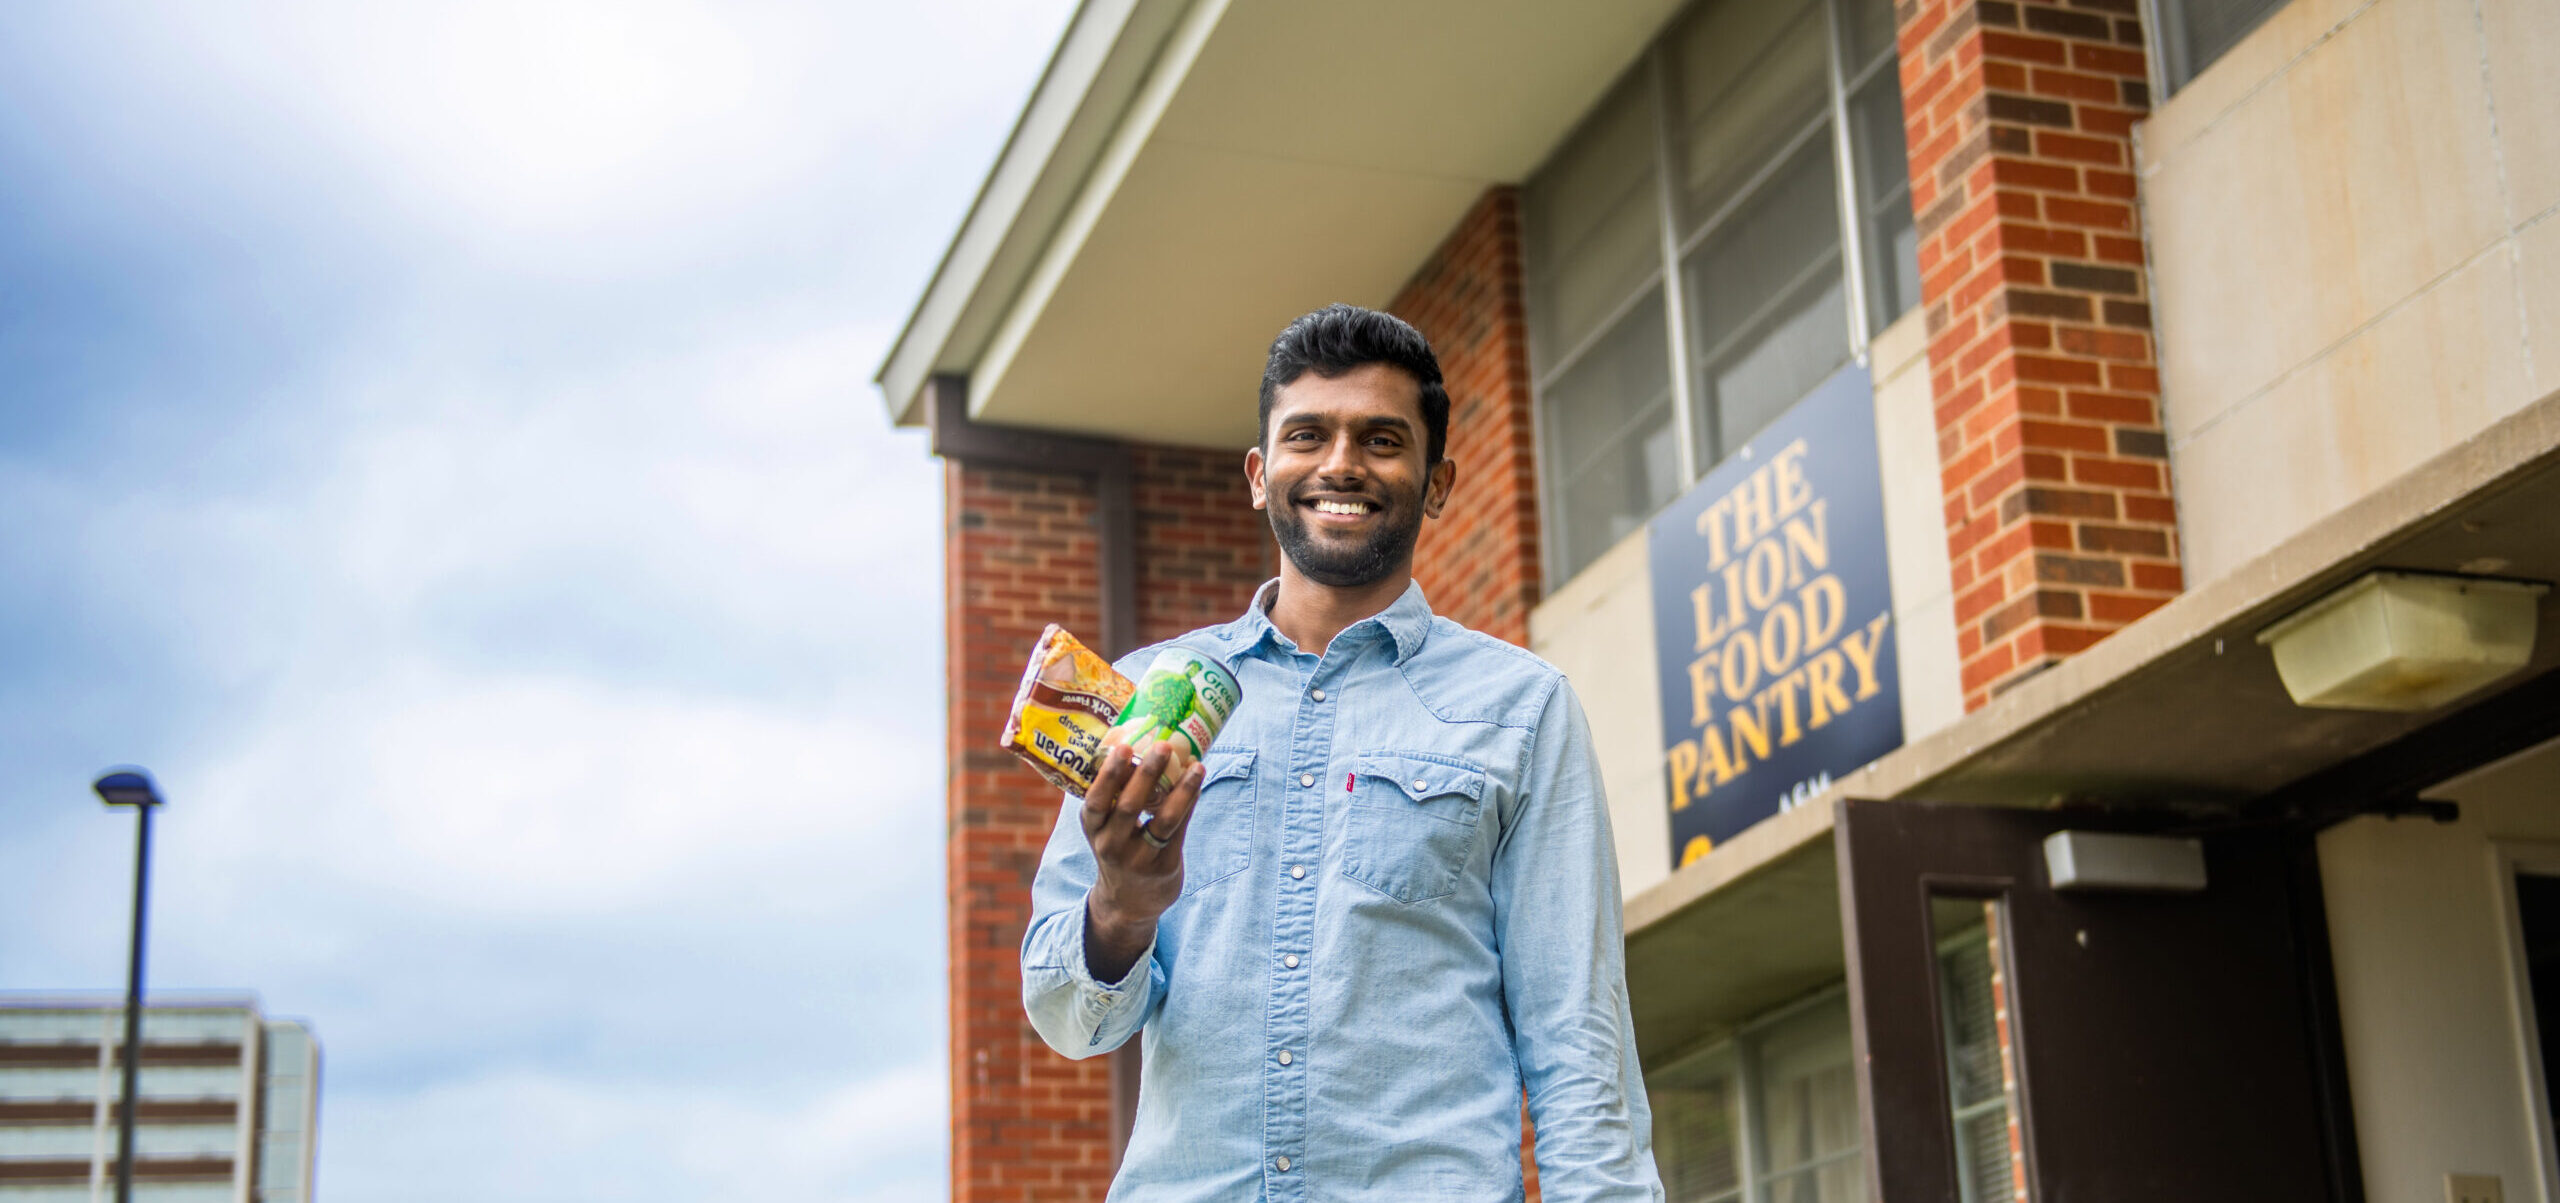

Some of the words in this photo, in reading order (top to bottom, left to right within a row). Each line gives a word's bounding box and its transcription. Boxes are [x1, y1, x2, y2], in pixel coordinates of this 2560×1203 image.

[1696, 437, 1812, 572] THE
[1690, 498, 1829, 652] LION
[1688, 573, 1847, 727] FOOD
[1058, 714, 1086, 741] Soup
[1062, 694, 1090, 706] Flavor
[1091, 698, 1119, 727] Pork
[1201, 687, 1226, 721] Gian
[1669, 615, 1888, 812] PANTRY
